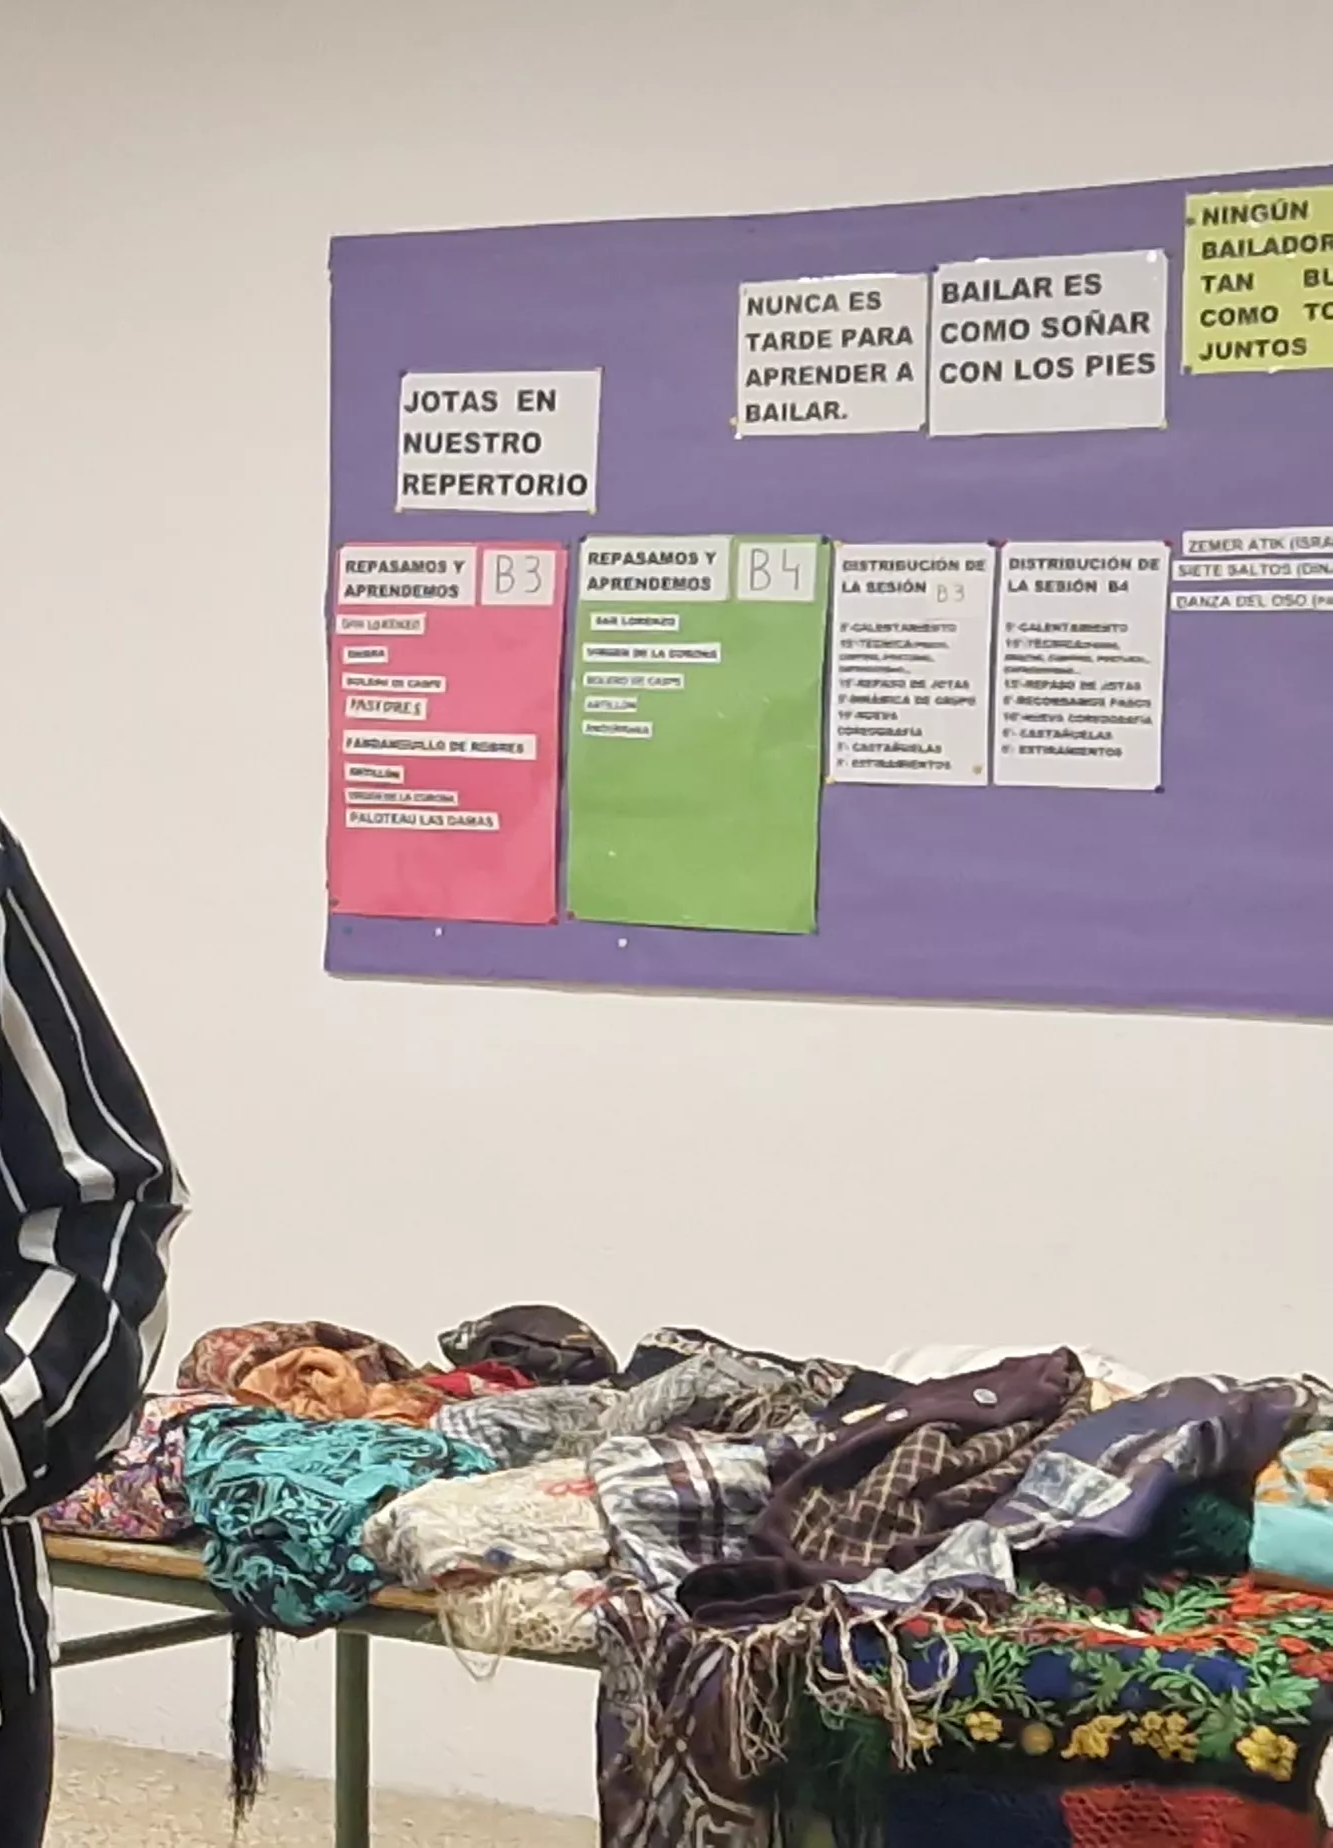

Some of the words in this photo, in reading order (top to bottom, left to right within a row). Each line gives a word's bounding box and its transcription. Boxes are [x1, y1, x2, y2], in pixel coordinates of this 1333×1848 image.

[1202, 198, 1309, 226] NINGÚN
[941, 276, 1053, 304] BAILAR
[1064, 273, 1103, 297] ES
[1200, 272, 1255, 293] TAN
[746, 293, 840, 317] NUNCA
[848, 291, 882, 312] ES
[940, 318, 1030, 344] COMO
[1041, 309, 1151, 339] SOÑAR
[1199, 304, 1279, 327] COMO
[745, 329, 833, 352] TARDE
[841, 325, 914, 348] PARA
[1199, 337, 1308, 361] JUNTOS
[745, 363, 888, 388] APRENDER
[896, 361, 914, 382] A
[939, 360, 1002, 384] CON
[1014, 357, 1074, 381] LOS
[1085, 352, 1156, 378] PIES
[404, 390, 498, 413] JOTAS
[517, 389, 556, 412] EN
[745, 400, 848, 423] BAILAR.
[403, 432, 542, 454] NUESTRO
[402, 473, 588, 496] REPERTORIO
[345, 560, 447, 574] REPASAMOS
[453, 560, 466, 574] Y
[587, 551, 699, 565] REPASAMOS
[705, 551, 717, 565] Y
[843, 557, 960, 571] DISTRIBUCIÓN
[965, 560, 986, 571] DE
[1008, 555, 1132, 570] DISTRIBUCIÓN
[1138, 558, 1160, 571] DE
[1178, 564, 1222, 577] SIETE
[1228, 563, 1291, 576] SALTOS
[344, 584, 459, 599] APRENDEMOS
[587, 576, 712, 591] APRENDEMOS
[841, 581, 861, 593] LA
[866, 579, 926, 593] SESIÓN
[1007, 580, 1028, 593] LA
[1034, 578, 1097, 592] SESIÓN
[1176, 595, 1231, 608] DANZA
[1236, 595, 1266, 607] DEL
[1271, 594, 1306, 606] OSO
